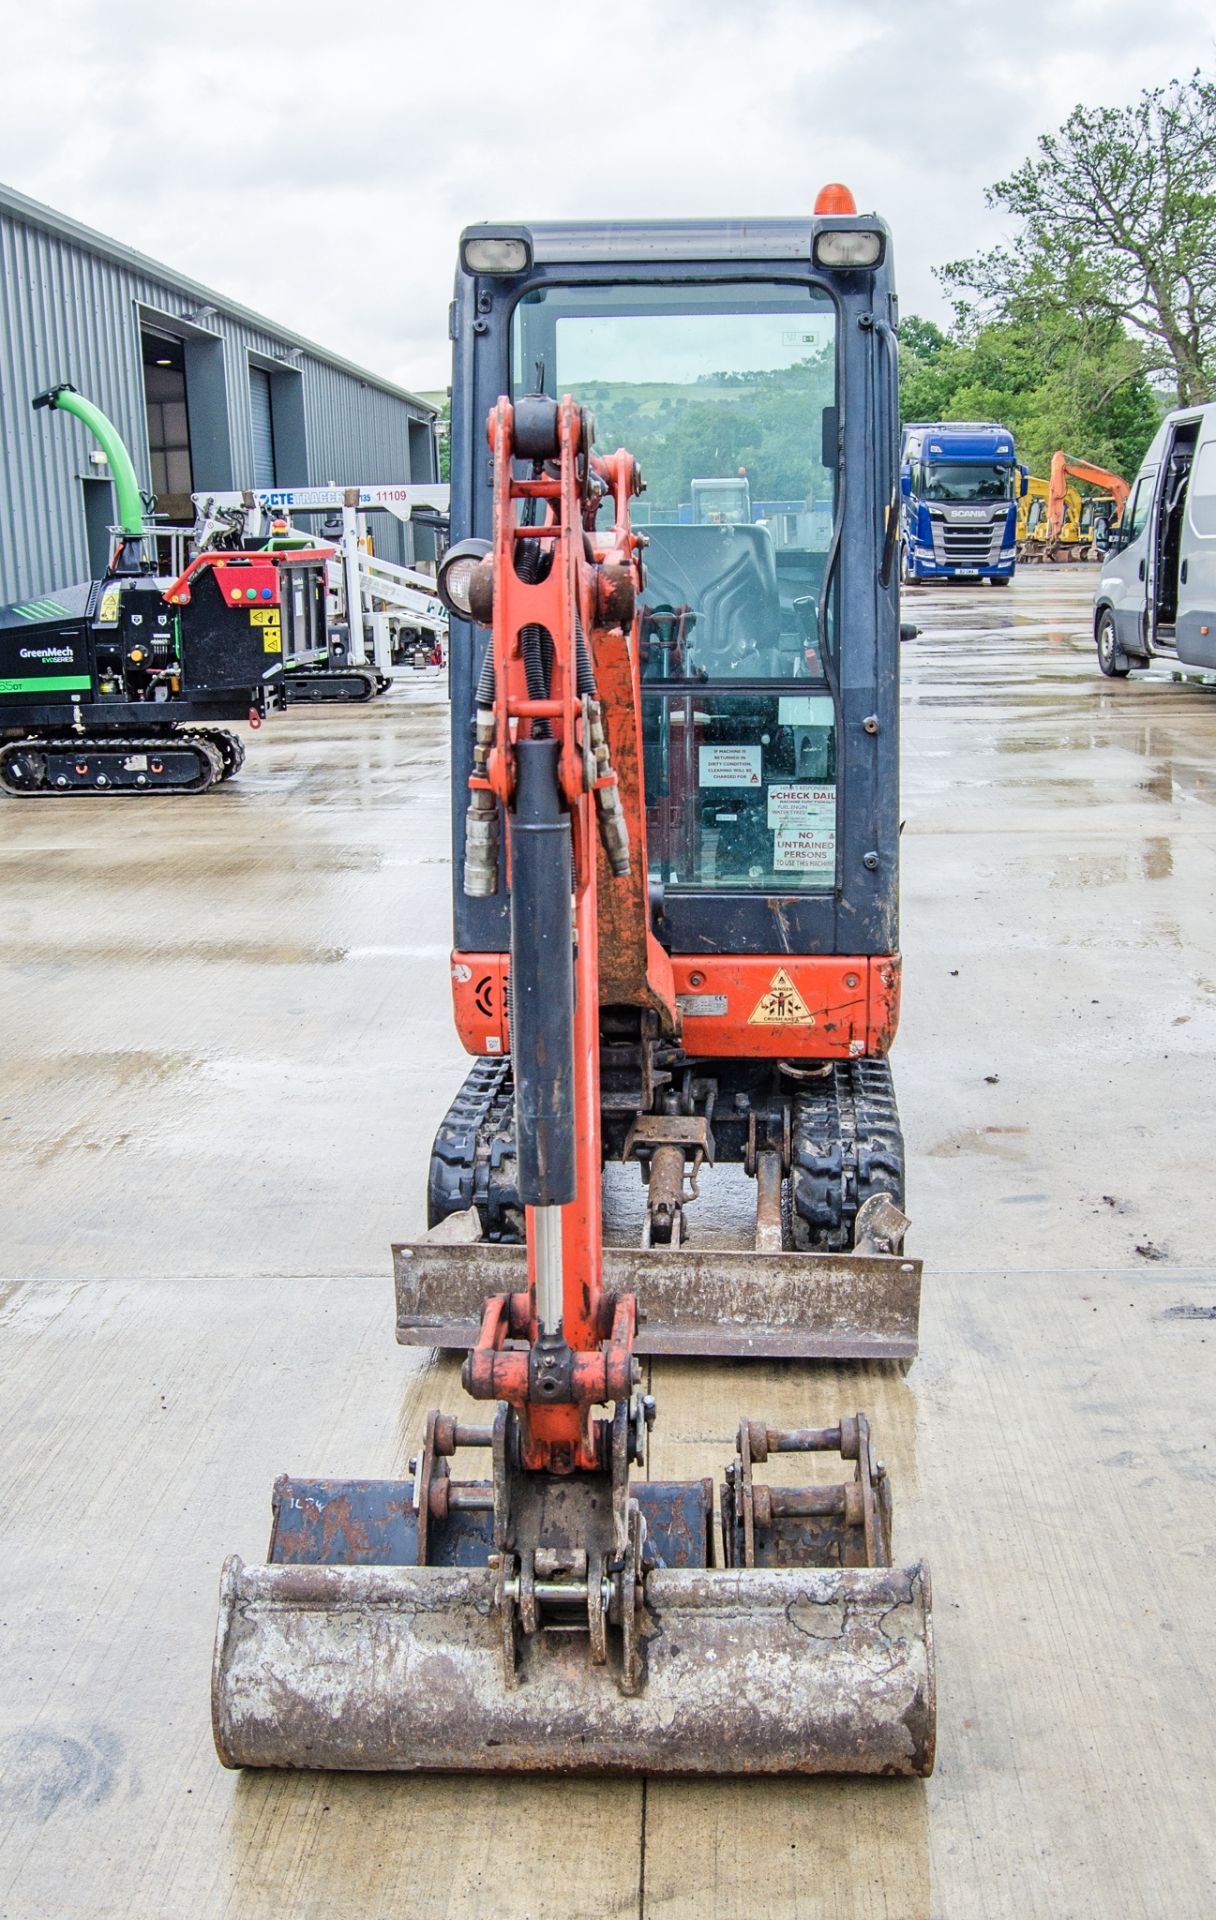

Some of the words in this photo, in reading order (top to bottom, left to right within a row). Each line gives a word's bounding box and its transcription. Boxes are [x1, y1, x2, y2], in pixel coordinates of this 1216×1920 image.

[271, 493, 294, 505] CTE
[376, 490, 407, 501] 11109
[951, 510, 987, 518] SCANIA
[19, 645, 74, 658] GreenMech
[776, 792, 810, 800] CHECK
[813, 792, 836, 800] DAIL
[777, 841, 834, 849] UNTRAINED
[784, 851, 827, 859] PERSONS
